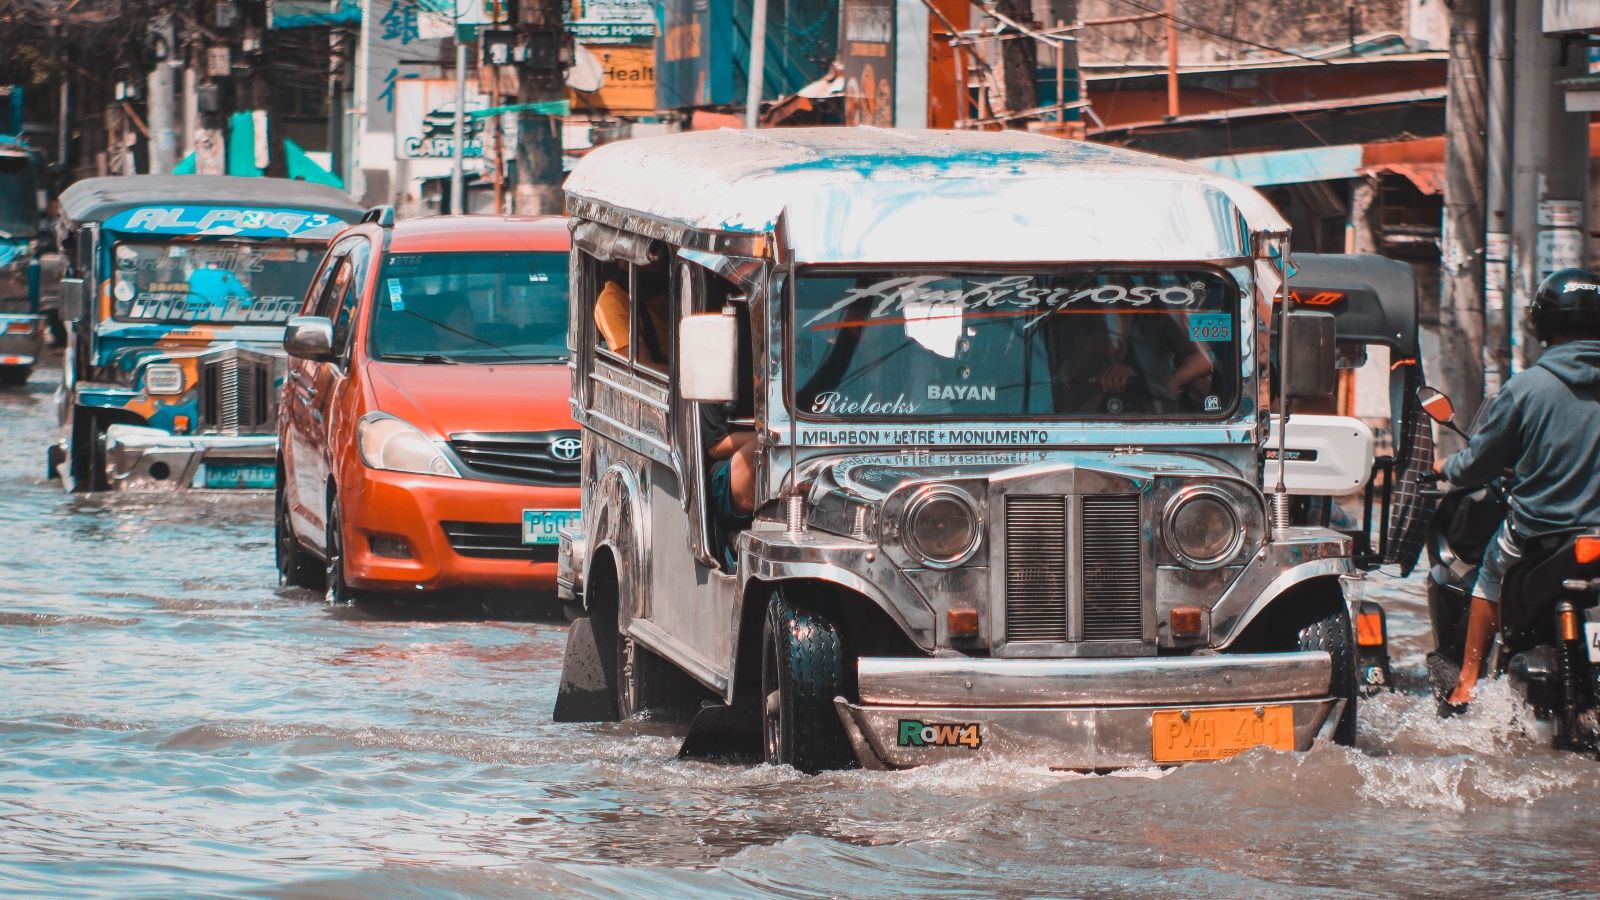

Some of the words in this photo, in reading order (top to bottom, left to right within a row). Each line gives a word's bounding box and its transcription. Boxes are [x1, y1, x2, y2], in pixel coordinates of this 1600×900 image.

[611, 26, 655, 36] HOME
[305, 213, 330, 228] 3
[1192, 326, 1229, 338] 2025
[927, 385, 996, 401] BAYAN
[811, 391, 920, 414] Rielocks
[803, 430, 880, 445] MALABON
[893, 430, 936, 445] LETRE
[950, 430, 1049, 445] MONUMENTO
[1166, 717, 1216, 749] PXH
[1233, 714, 1279, 746] 401
[1216, 747, 1250, 757] JEEPN
